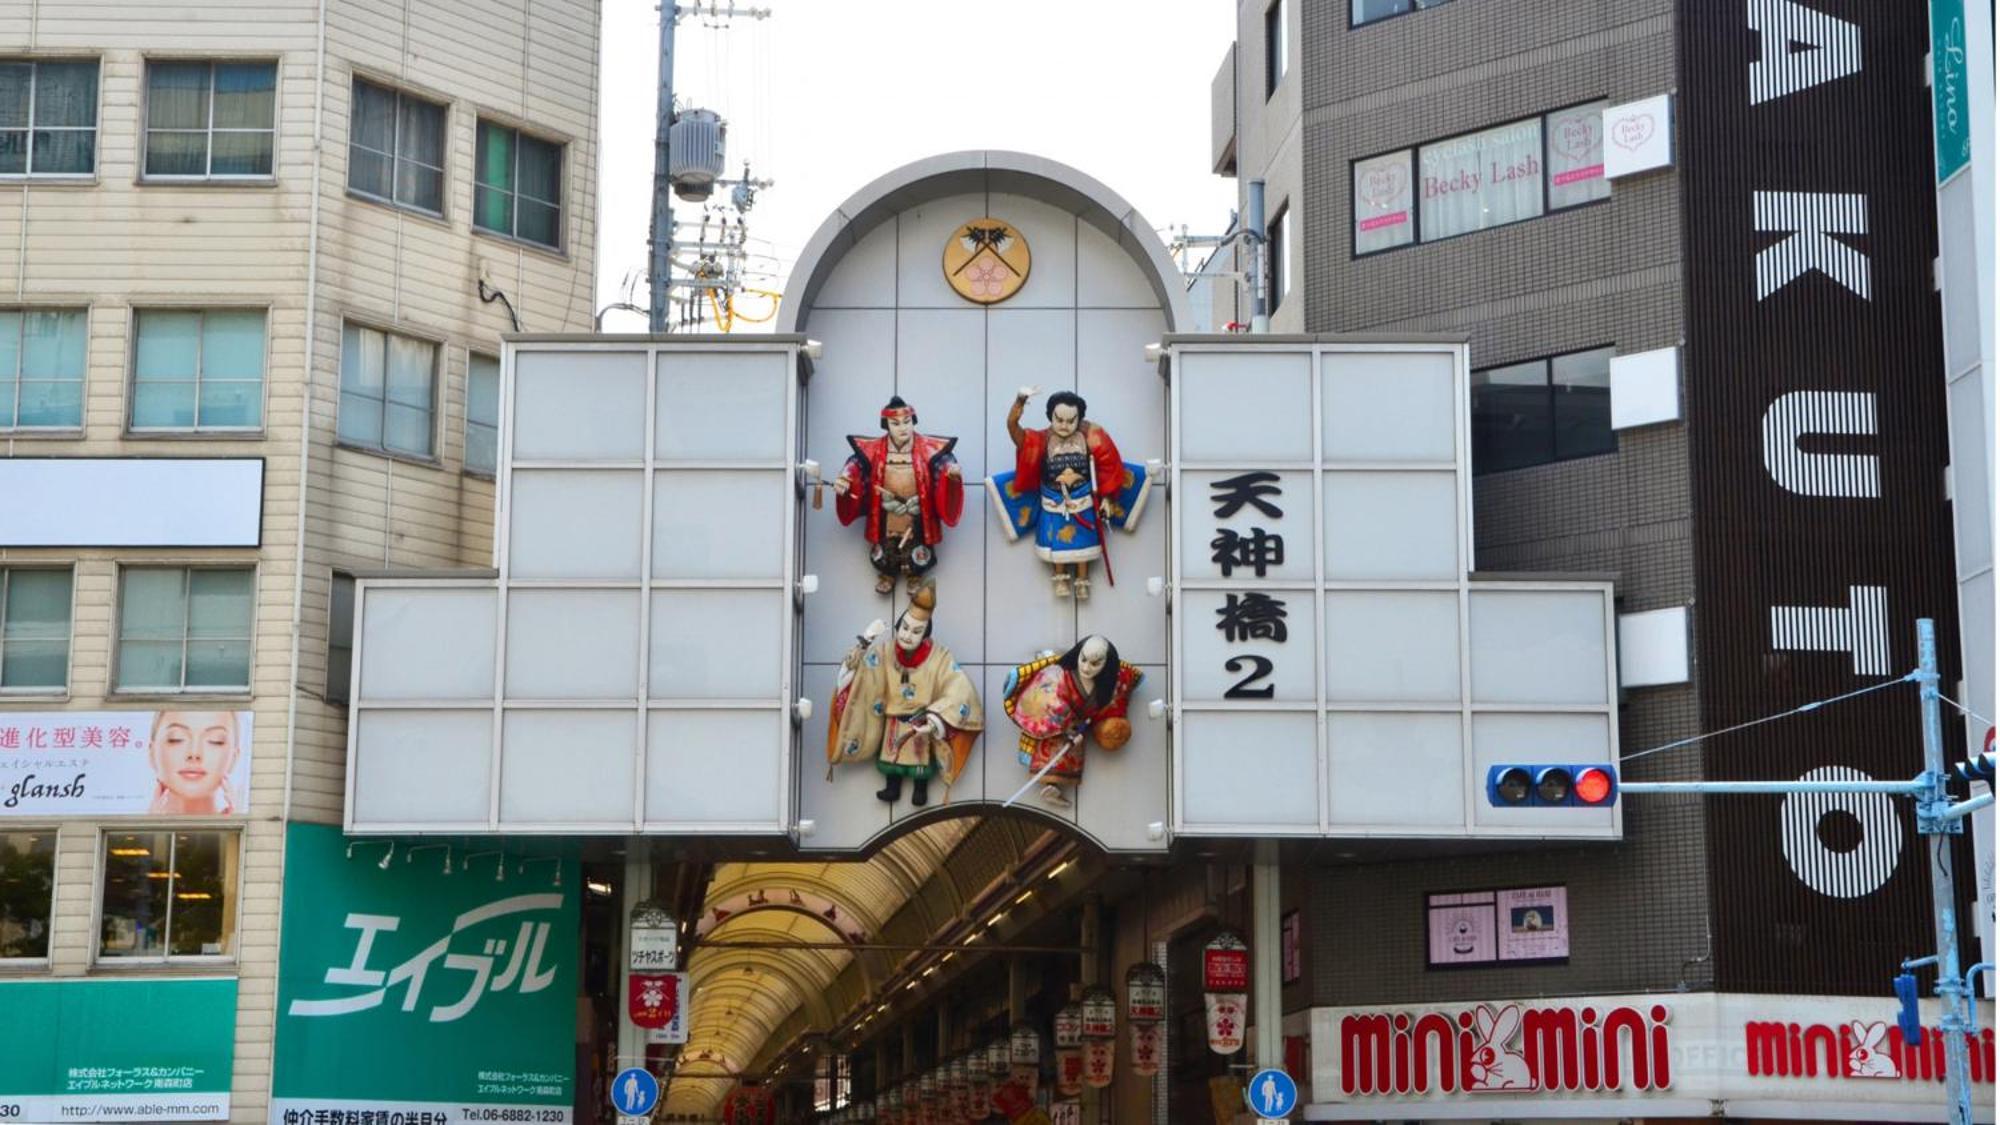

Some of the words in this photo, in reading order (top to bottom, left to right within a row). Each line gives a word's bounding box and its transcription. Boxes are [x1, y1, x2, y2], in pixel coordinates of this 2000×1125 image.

[1944, 17, 1963, 135] Lino
[1564, 123, 1593, 139] Becky
[1621, 122, 1645, 134] Becky
[1424, 168, 1482, 199] Becky
[1492, 154, 1539, 184] Lash
[1210, 472, 1288, 700] 天神橋2
[0, 727, 143, 749] 進化型美容。
[288, 893, 564, 1023] エイブル
[1340, 1011, 1476, 1094] mini
[1523, 1004, 1671, 1091] mini
[1746, 1021, 1852, 1078] mini
